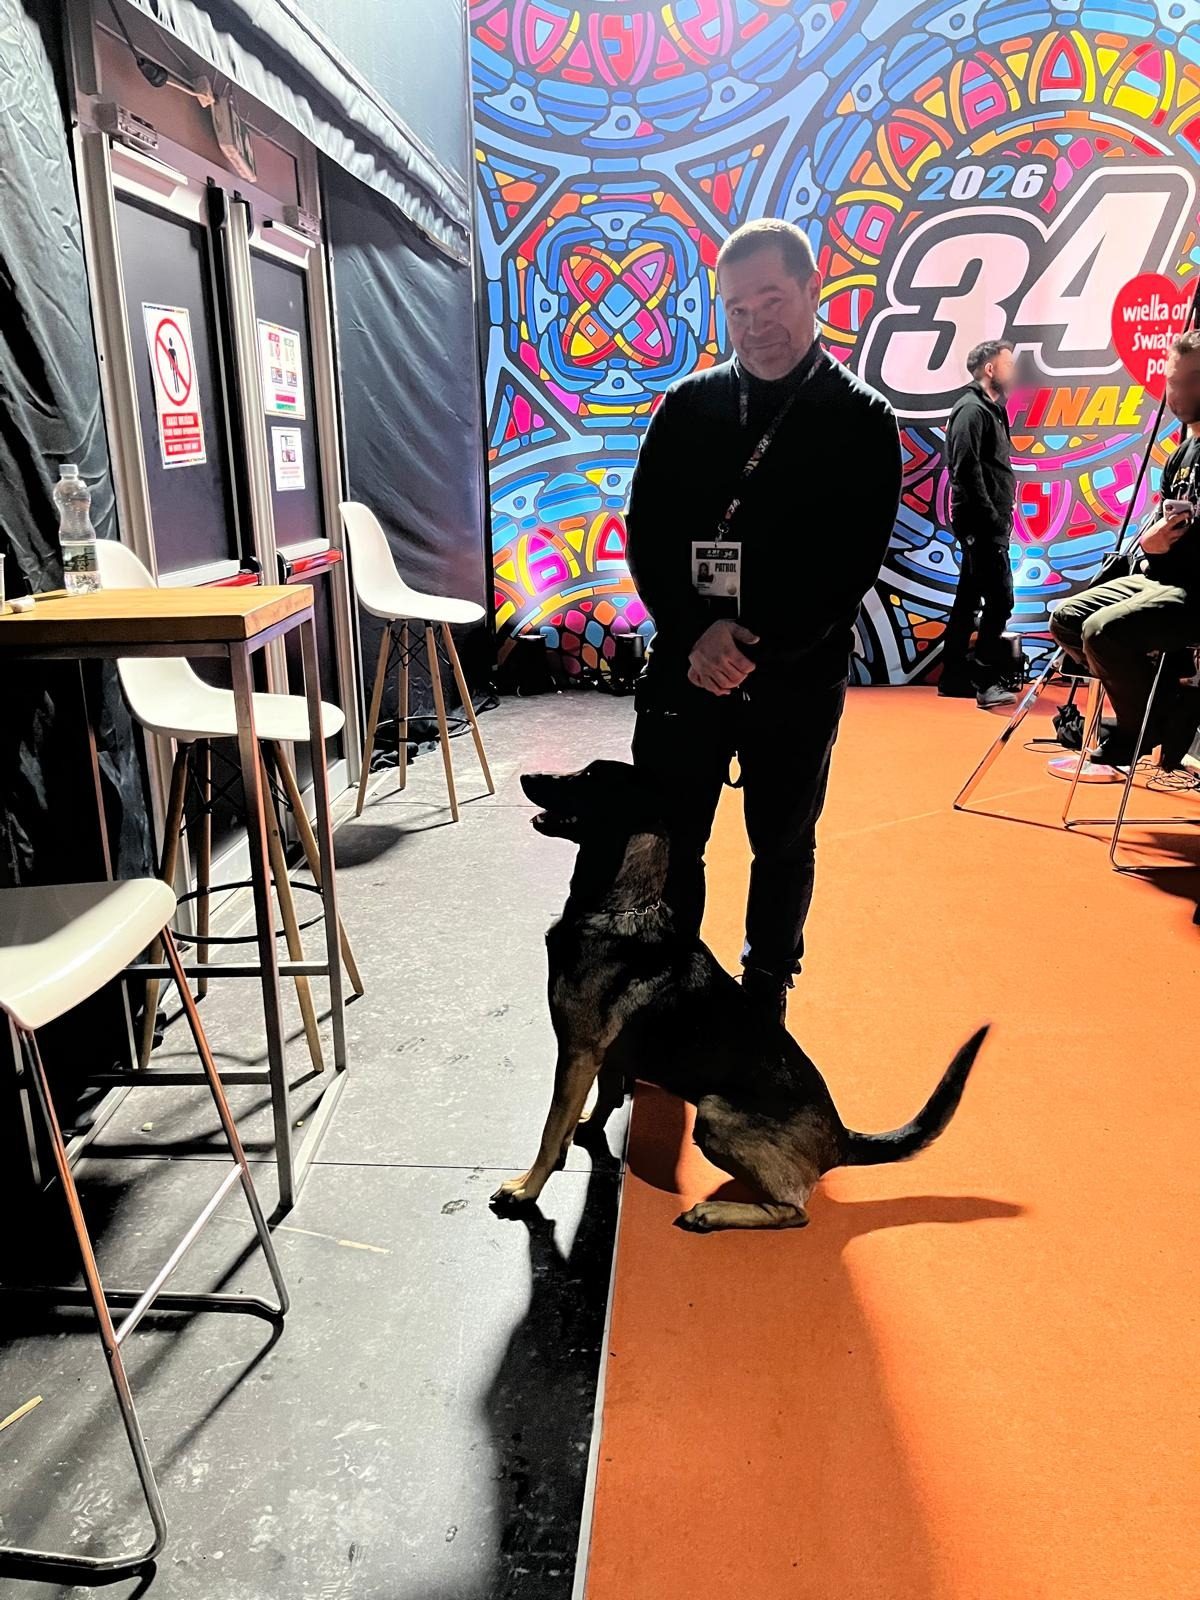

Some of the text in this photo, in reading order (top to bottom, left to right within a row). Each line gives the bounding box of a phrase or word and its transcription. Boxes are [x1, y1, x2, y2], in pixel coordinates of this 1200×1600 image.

[917, 163, 1048, 201] 2026
[878, 190, 1173, 396] 34
[1122, 293, 1169, 323] wielka
[714, 562, 737, 573] PATROL
